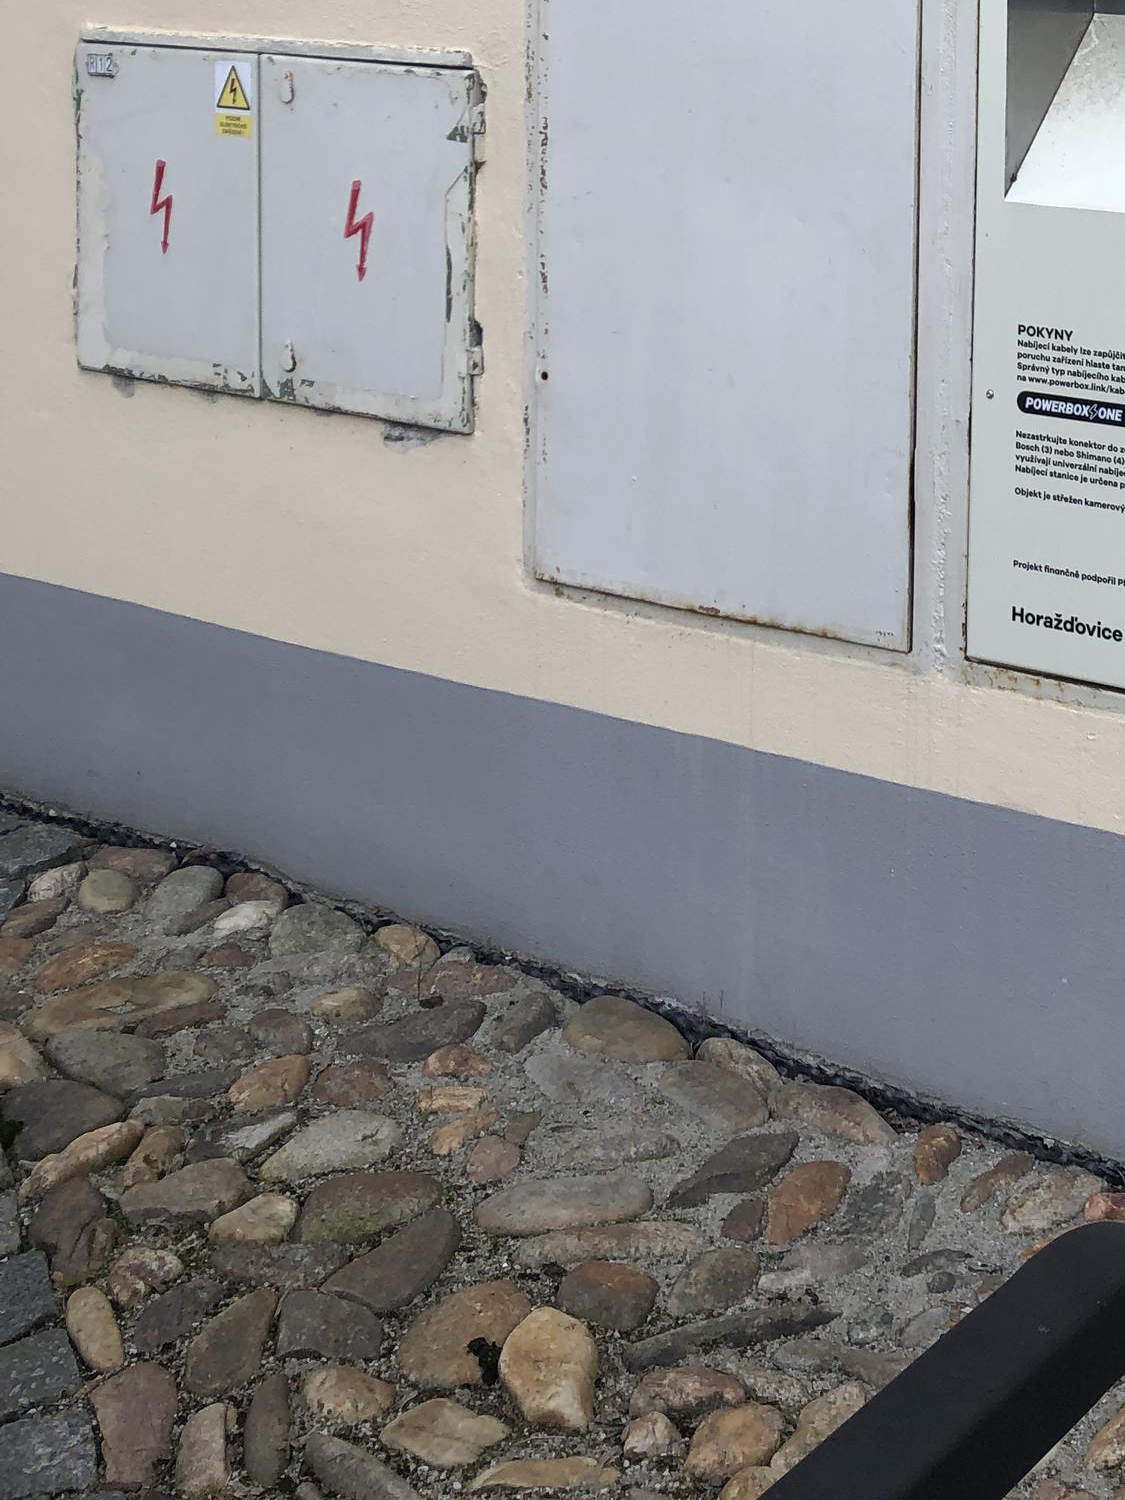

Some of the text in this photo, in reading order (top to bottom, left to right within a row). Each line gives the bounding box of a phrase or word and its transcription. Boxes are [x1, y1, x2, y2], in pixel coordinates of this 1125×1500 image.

[1017, 324, 1073, 341] POKYNY
[1016, 340, 1050, 352] Nabíjecí
[1051, 344, 1078, 357] kabely
[1079, 346, 1091, 356] lze
[1092, 350, 1125, 362] zapůjčit
[1016, 352, 1050, 363] poruchu
[1051, 356, 1084, 367] zařízení
[1085, 359, 1110, 370] hlaste
[1016, 362, 1050, 376] Správný
[1050, 366, 1065, 378] typ
[1066, 369, 1109, 381] nabíjecího
[1024, 398, 1124, 422] POWERBOX ONE
[1015, 431, 1067, 447] Nezastrkujte
[1068, 438, 1106, 451] konektor
[1106, 444, 1118, 453] do
[1015, 442, 1040, 454] Bosch
[1040, 446, 1052, 457] (3)
[1053, 450, 1074, 459] nebo
[1075, 451, 1112, 464] Shimano
[1112, 457, 1125, 468] (4)
[1015, 455, 1051, 469] využívají
[1052, 460, 1097, 473] univerzální
[1014, 465, 1048, 478] Nabíjecí
[1048, 470, 1079, 482] stanice
[1079, 474, 1088, 485] je
[1089, 477, 1118, 488] určena
[1014, 487, 1042, 500] Objekt
[1042, 492, 1051, 503] je
[1052, 494, 1083, 506] střežen
[1012, 560, 1043, 574] Projekt
[1043, 565, 1080, 579] finančně
[1081, 573, 1116, 585] podpořil
[1011, 605, 1123, 642] Horažďovice
